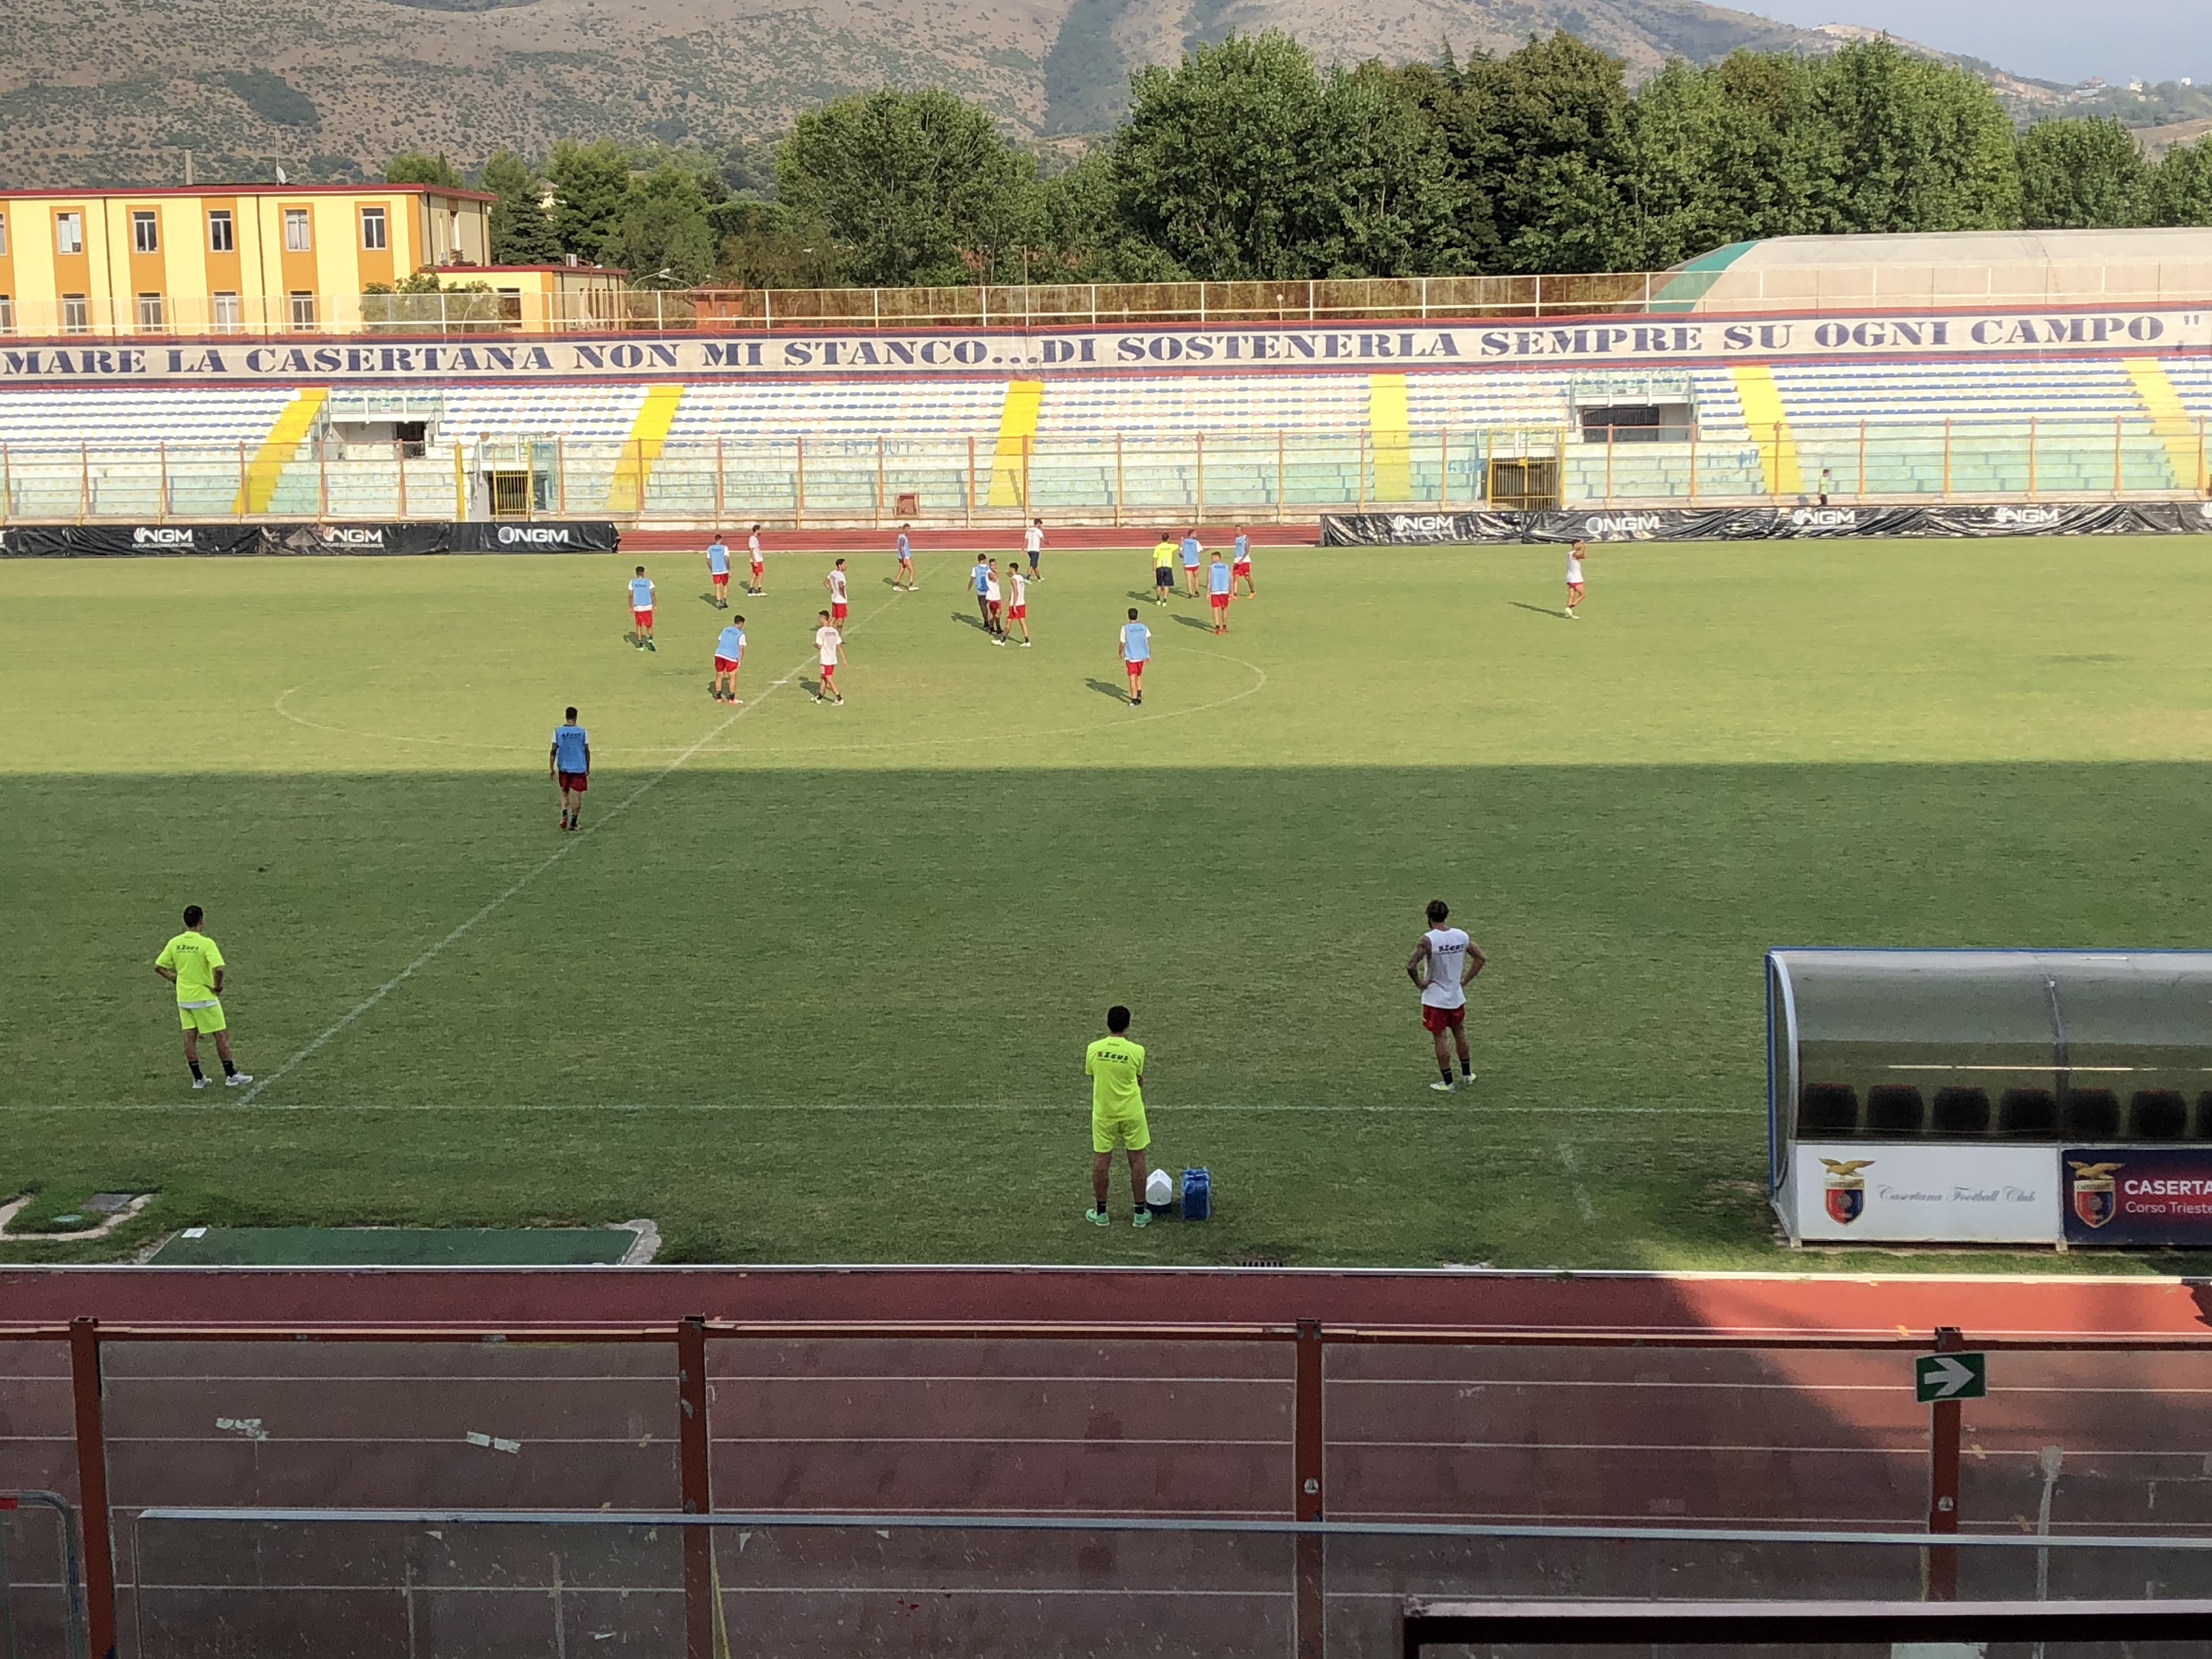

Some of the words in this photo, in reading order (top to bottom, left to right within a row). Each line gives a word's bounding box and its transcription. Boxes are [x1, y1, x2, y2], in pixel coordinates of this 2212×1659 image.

[3, 349, 146, 375] MARE
[166, 349, 228, 374] LA
[246, 346, 554, 373] CASERTANA
[573, 343, 680, 369] NON
[701, 342, 764, 367] MI
[1117, 332, 1462, 362] SOSTENERLA
[1481, 326, 1702, 356] SEMPRE
[1723, 324, 1794, 350] SU
[1814, 321, 1950, 347] OGNI
[1970, 315, 2164, 345] CAMPO
[1792, 509, 1855, 525] NGM
[1995, 506, 2058, 522] NGM
[1394, 515, 1453, 531] NGM
[133, 527, 193, 543] NGM
[323, 527, 382, 543] NGM
[2125, 1180, 2212, 1195] CASERTA
[2126, 1201, 2166, 1213] Corso
